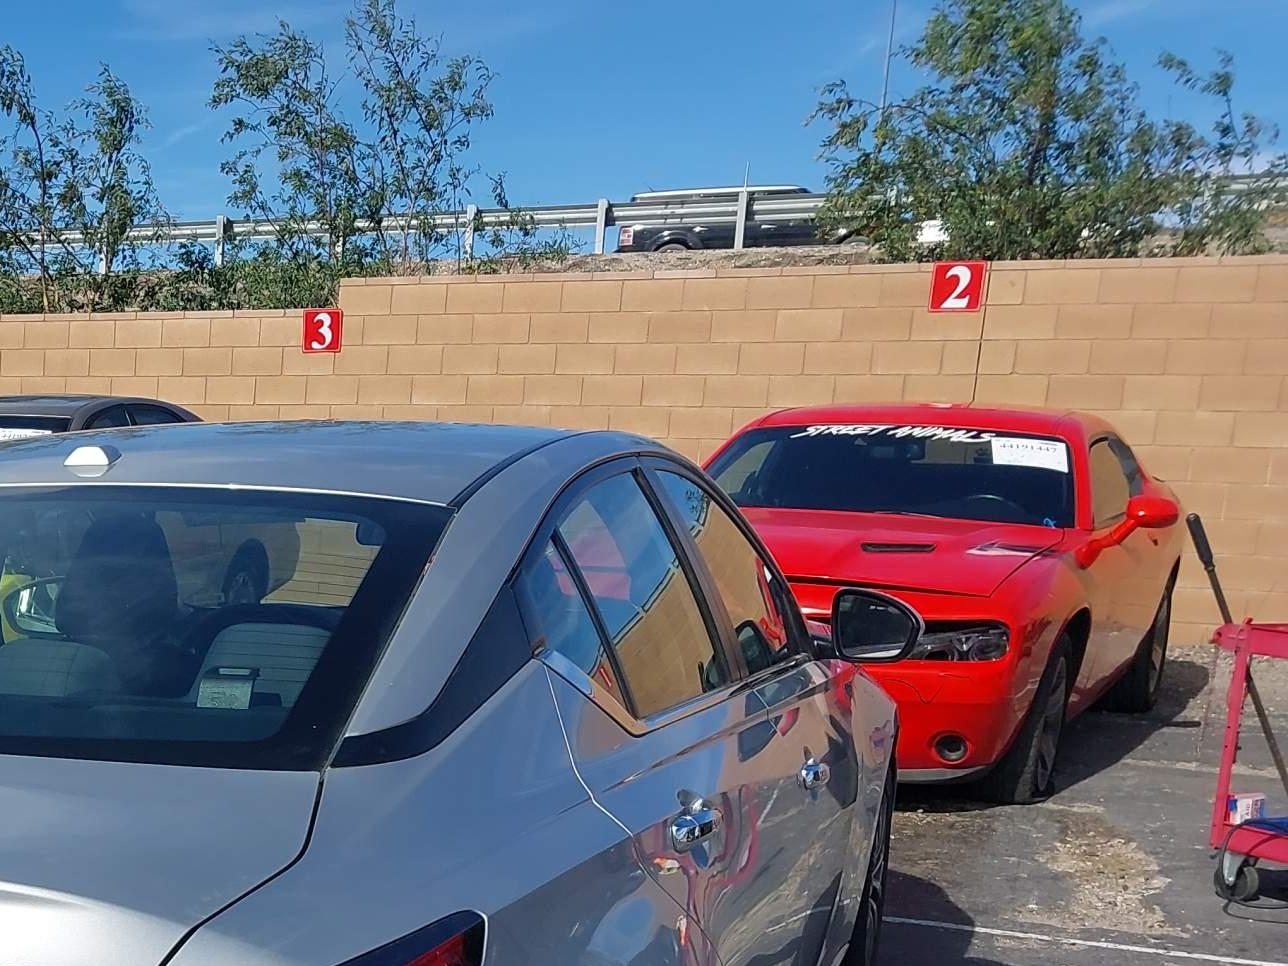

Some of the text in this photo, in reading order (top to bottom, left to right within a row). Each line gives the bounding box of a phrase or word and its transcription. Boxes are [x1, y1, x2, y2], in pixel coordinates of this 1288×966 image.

[940, 264, 972, 309] 2
[311, 312, 332, 349] 3
[790, 425, 996, 443] STREET ANIMALS
